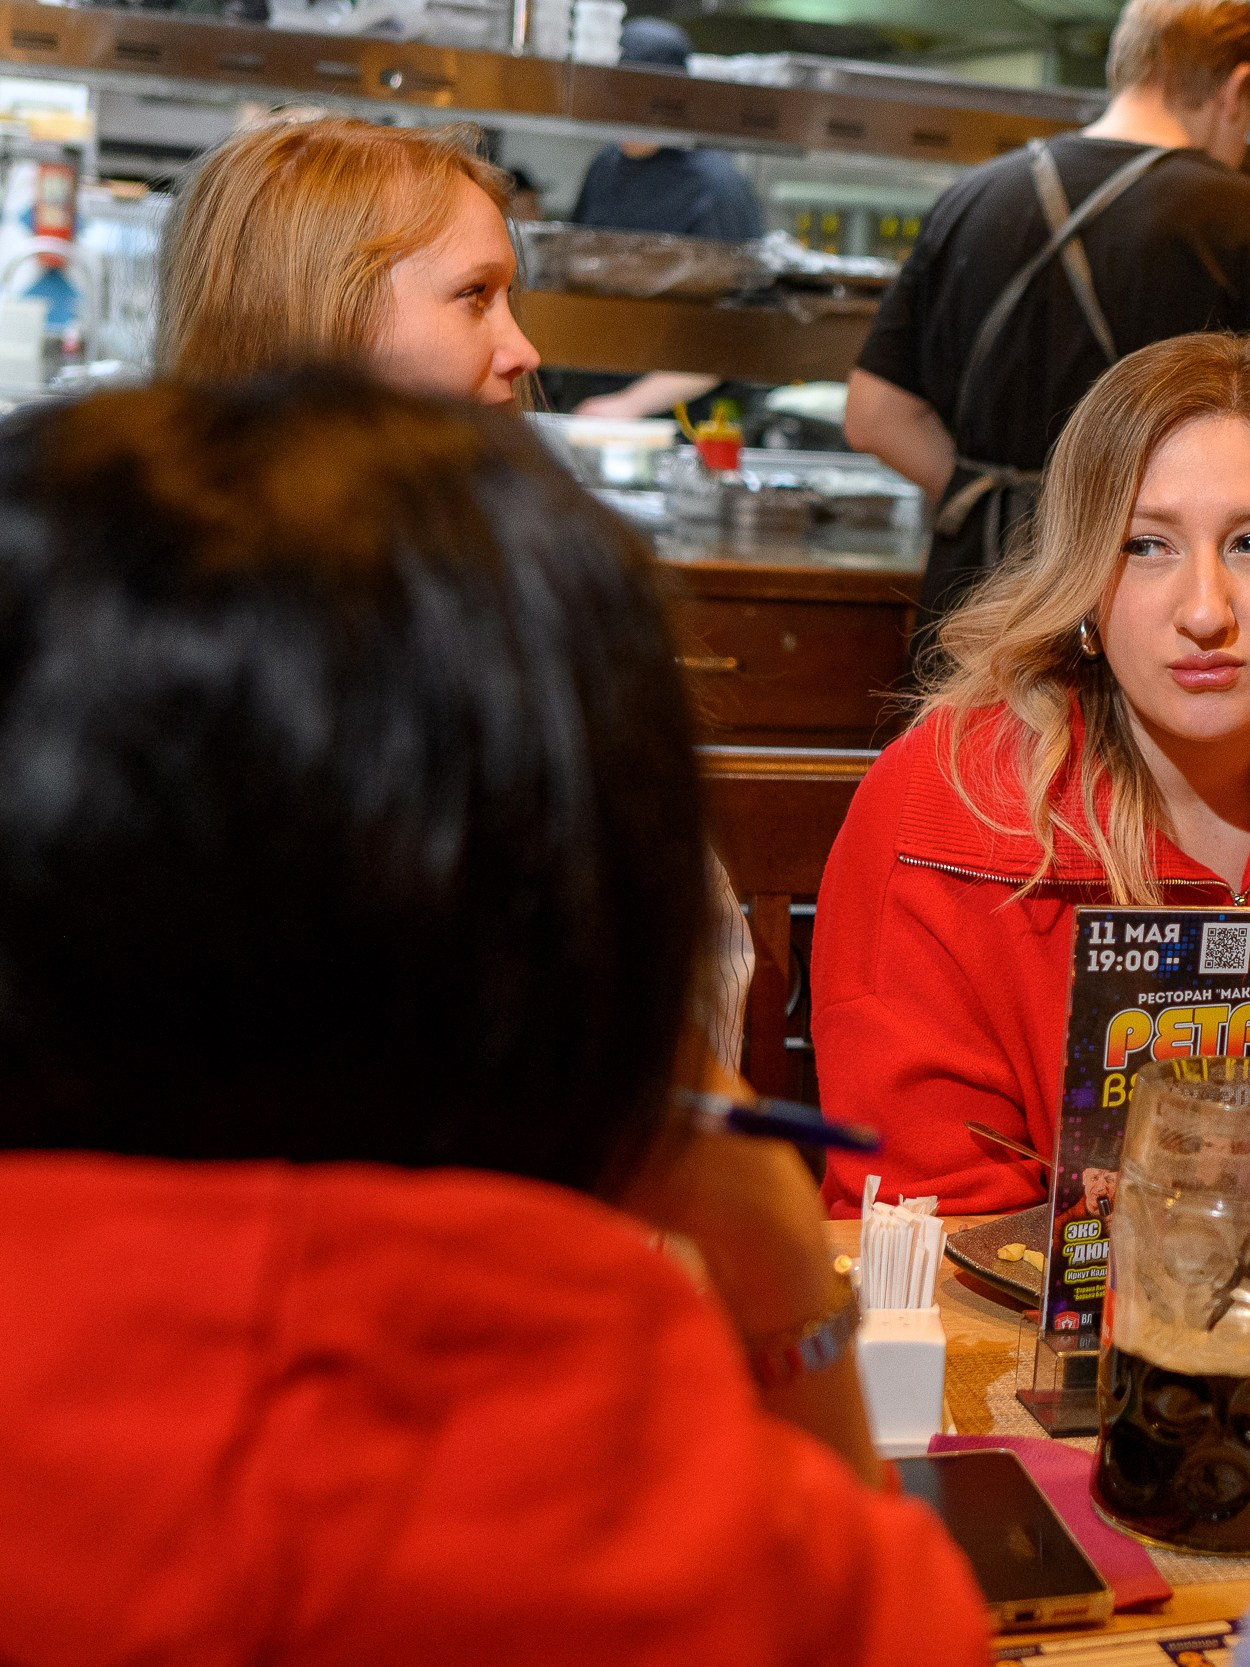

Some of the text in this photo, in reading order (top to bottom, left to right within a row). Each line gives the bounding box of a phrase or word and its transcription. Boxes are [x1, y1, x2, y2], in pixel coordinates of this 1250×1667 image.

[1088, 921, 1181, 944] 11 МАЯ
[1087, 950, 1159, 972] 19:00
[1138, 989, 1212, 1005] РЕСТОРАН
[1067, 1222, 1098, 1240] ЭКС
